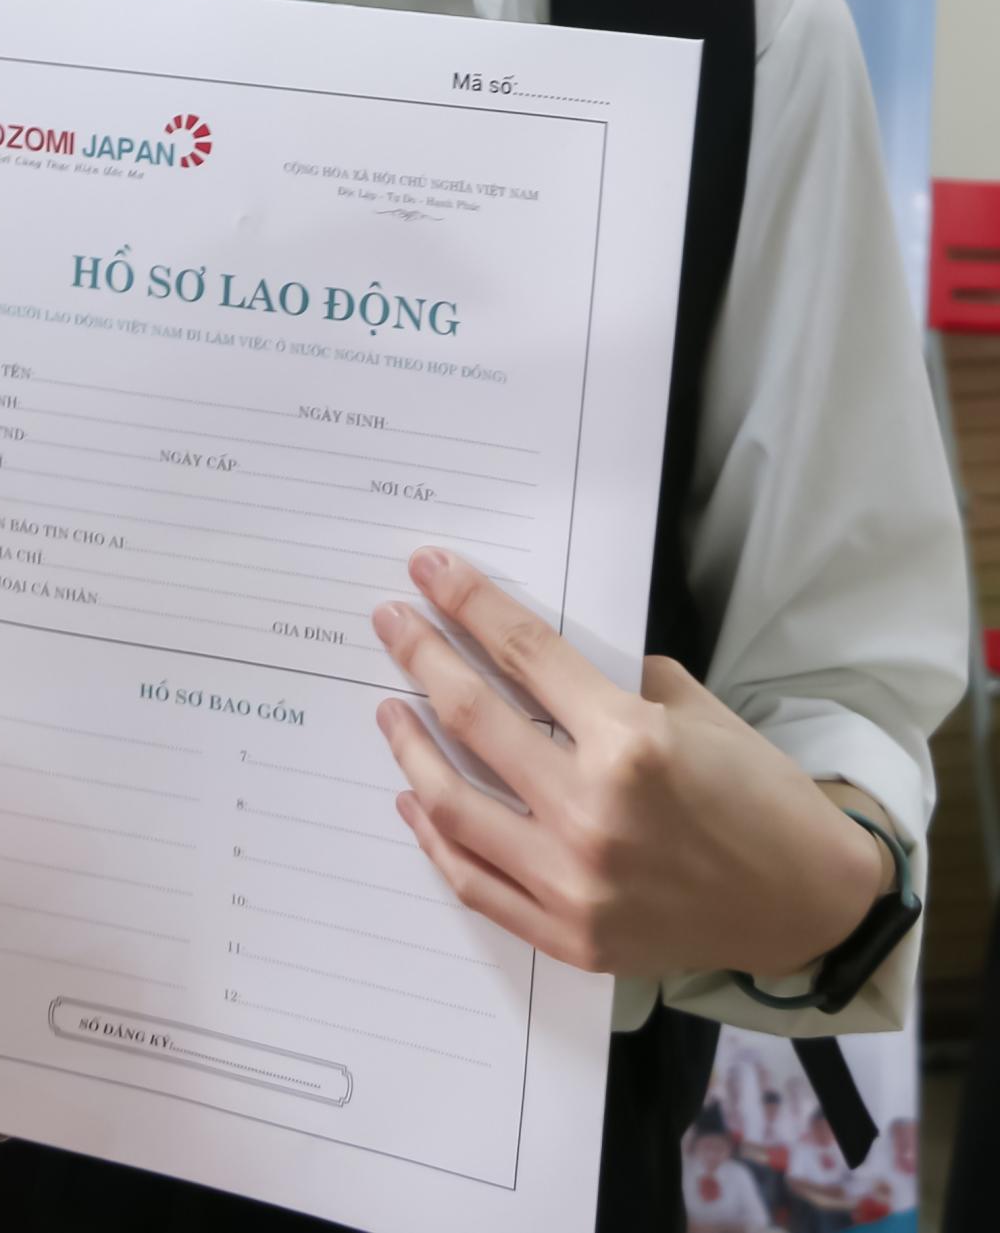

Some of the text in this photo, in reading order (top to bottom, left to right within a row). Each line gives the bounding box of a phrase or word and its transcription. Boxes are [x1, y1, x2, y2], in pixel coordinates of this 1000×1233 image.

[452, 72, 484, 93] Mã
[82, 134, 175, 167] JAPAN
[71, 244, 461, 337] HỒ SƠ LAO ĐỘNG
[45, 310, 71, 324] LAO
[151, 324, 183, 340] NAM
[383, 355, 424, 372] THEO
[369, 479, 400, 497] NƠI
[43, 524, 69, 540] TIN
[72, 528, 105, 546] CHO
[271, 620, 300, 639] GIA
[174, 687, 203, 708] SƠ
[209, 694, 251, 717] BAO
